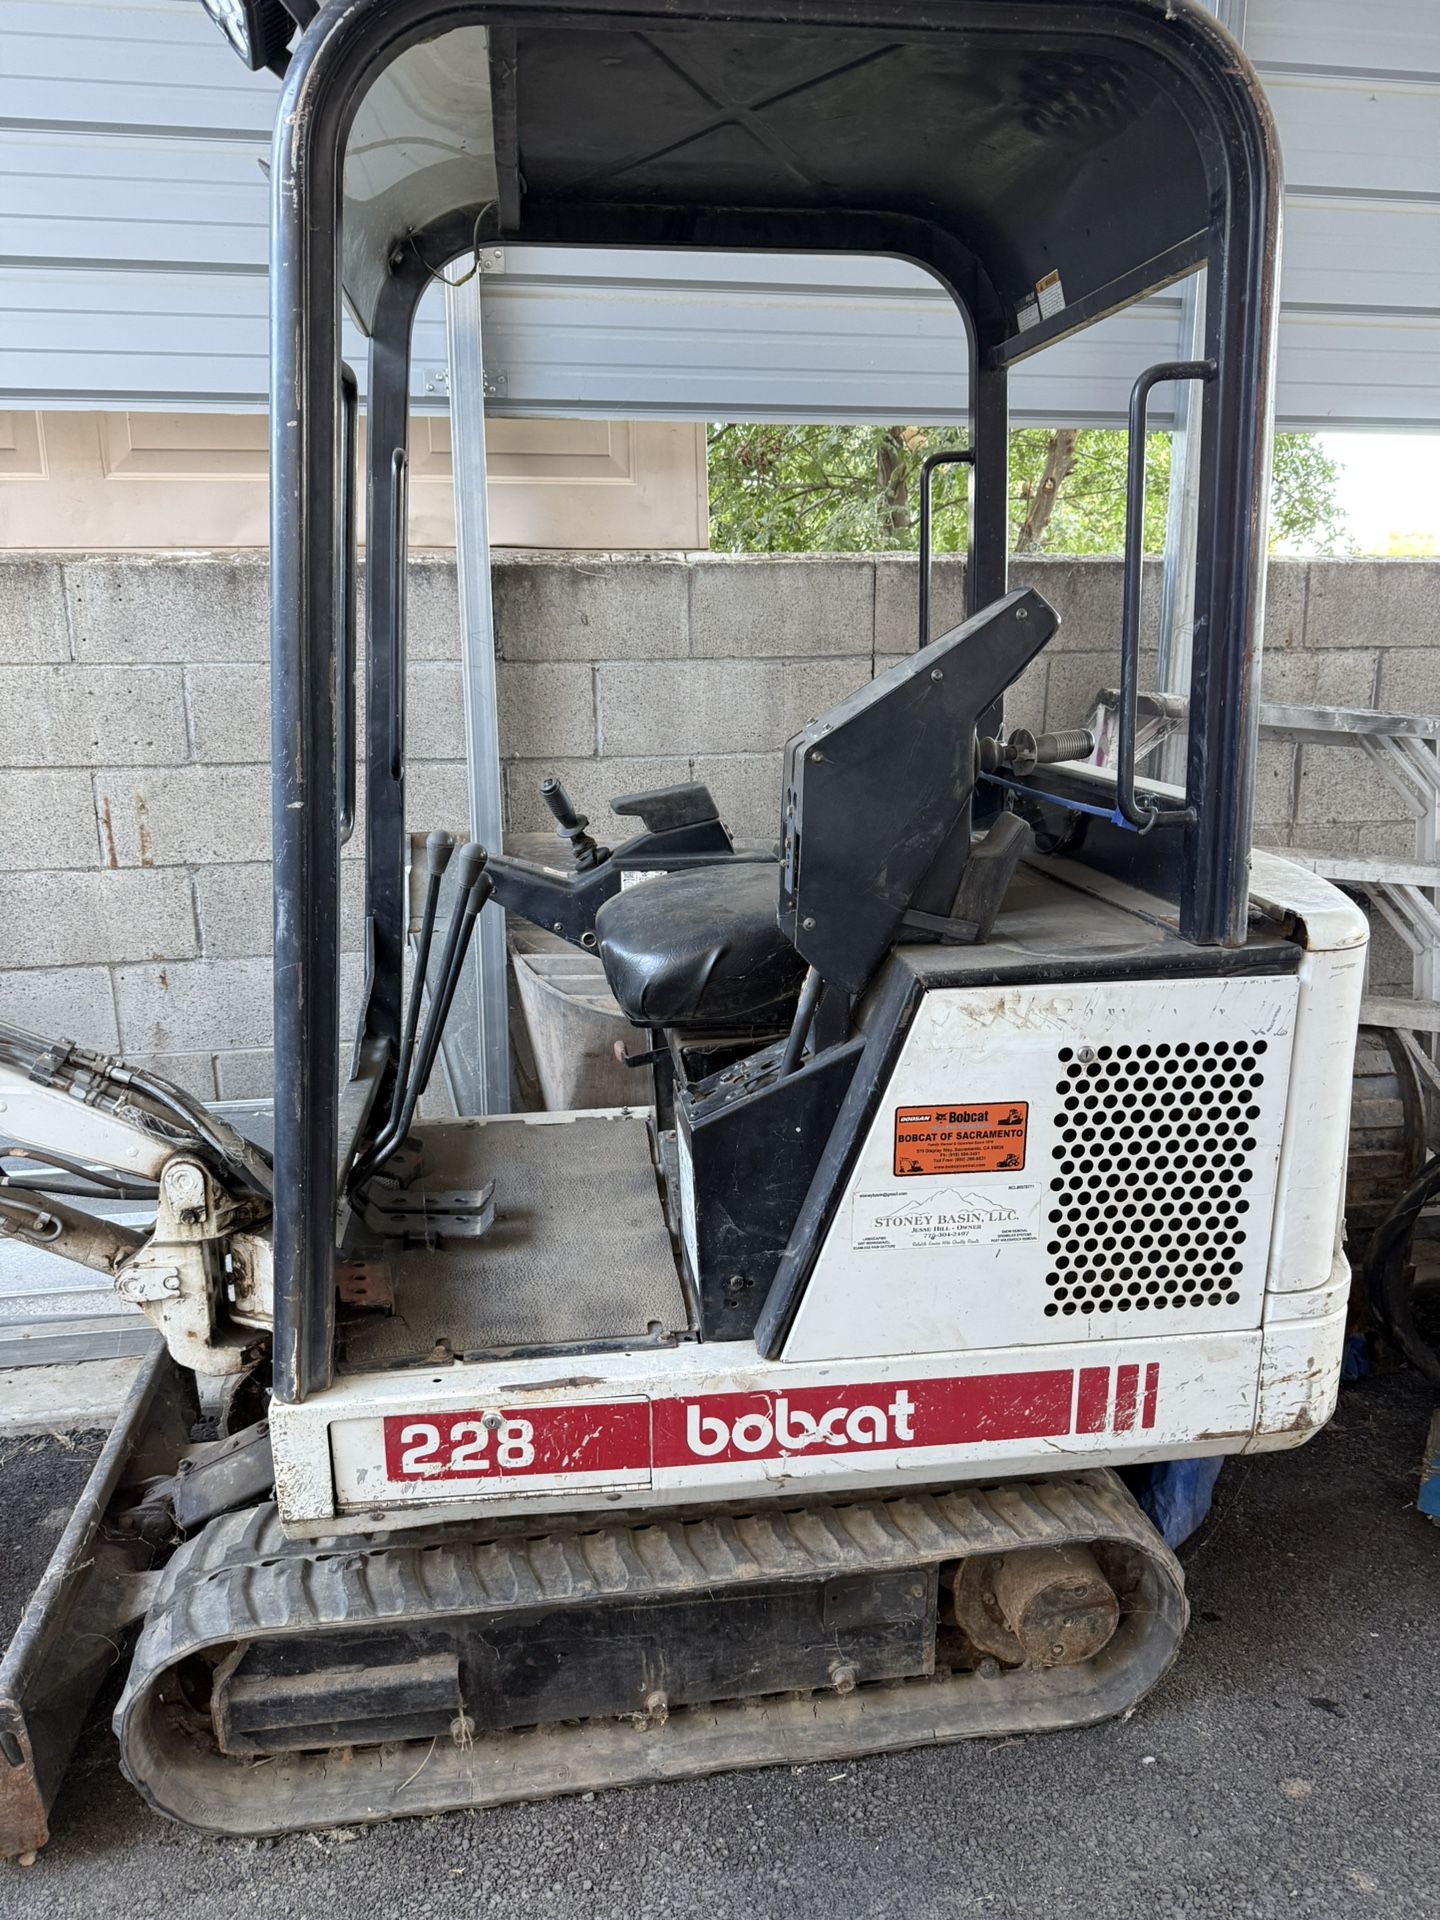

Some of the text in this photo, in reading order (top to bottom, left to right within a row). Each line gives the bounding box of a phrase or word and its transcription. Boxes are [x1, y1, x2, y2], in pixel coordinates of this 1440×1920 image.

[949, 1111, 988, 1123] Bobcat
[898, 1129, 1024, 1143] BOBCAT OF SACRAMENTO
[874, 1211, 1020, 1228] STONEY BASIN, LLC.
[686, 1390, 915, 1457] bobcat
[400, 1420, 535, 1474] 228
